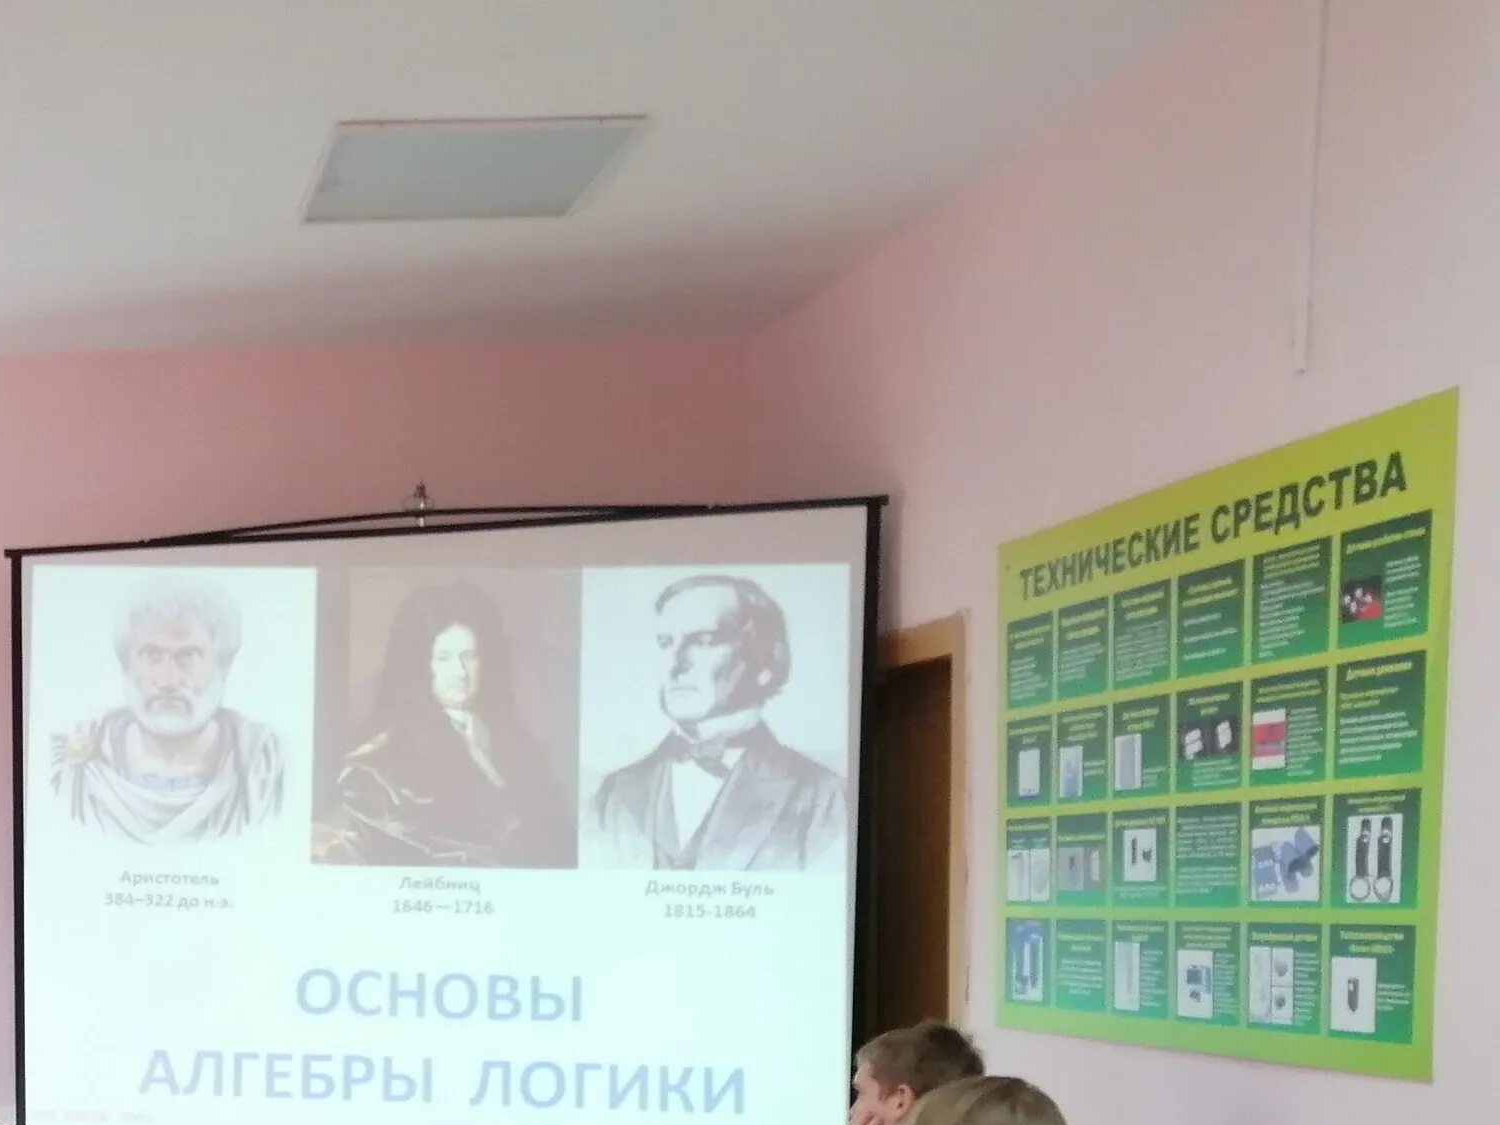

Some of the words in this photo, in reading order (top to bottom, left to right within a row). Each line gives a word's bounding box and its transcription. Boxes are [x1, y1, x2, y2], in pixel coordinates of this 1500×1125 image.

[1019, 512, 1201, 600] ТЕХНИЧЕСКИЕ
[1210, 451, 1407, 544] СРЕДСТВА
[119, 870, 220, 886] Аристотель
[399, 876, 481, 895] Лейбниц
[644, 880, 727, 897] Джордж
[731, 881, 775, 897] Буль
[296, 968, 582, 1021] ОСНОВЫ
[139, 1050, 433, 1103] АЛГЕБРЫ
[469, 1060, 745, 1114] ЛОГИКИ
